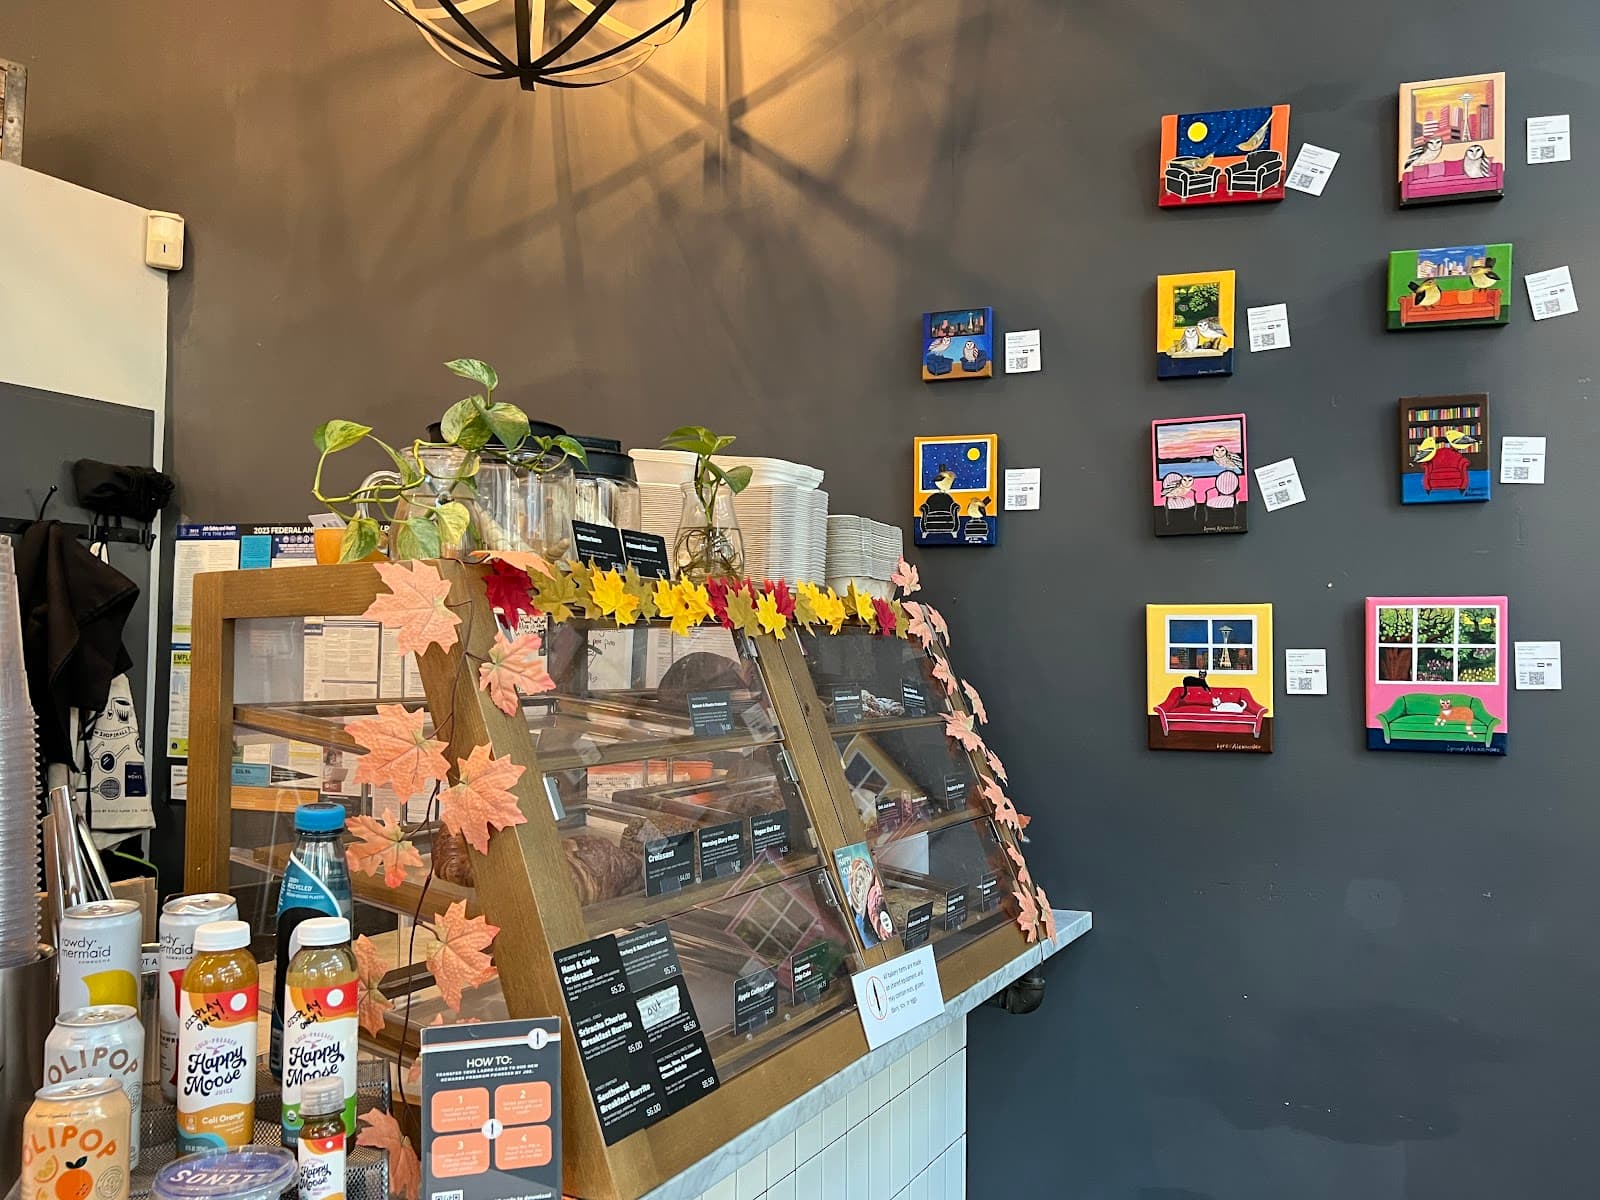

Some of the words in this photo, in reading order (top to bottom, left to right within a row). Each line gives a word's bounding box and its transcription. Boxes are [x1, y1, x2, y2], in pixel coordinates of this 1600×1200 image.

[253, 527, 270, 535] 2023
[270, 526, 302, 534] FEDERAL
[648, 849, 675, 863] Croissant
[62, 944, 112, 959] mermaid
[560, 963, 577, 974] Ham
[581, 955, 600, 968] Swiss
[563, 968, 594, 985] Croissant
[185, 1000, 222, 1031] DISPLAY
[578, 1021, 605, 1038] Sriracha
[604, 1012, 628, 1027] Chorizo
[581, 1028, 612, 1049] Breakfast
[611, 1021, 633, 1035] Burrito
[187, 1045, 247, 1075] Happy
[288, 1041, 345, 1068] Happy
[466, 1056, 493, 1068] HOW
[495, 1055, 513, 1065] TO:
[47, 1046, 139, 1085] OLIPOP
[184, 1068, 242, 1097] Moose
[286, 1064, 339, 1088] Moose
[458, 1095, 463, 1104] 1
[520, 1089, 526, 1099] 2
[596, 1081, 630, 1103] Southwest
[600, 1093, 631, 1114] Breakfast
[629, 1083, 651, 1099] Burrito
[23, 1125, 117, 1167] OLIPOP
[458, 1141, 464, 1150] 3
[521, 1134, 527, 1142] 4
[300, 1163, 332, 1179] Happy
[300, 1176, 329, 1191] Moose
